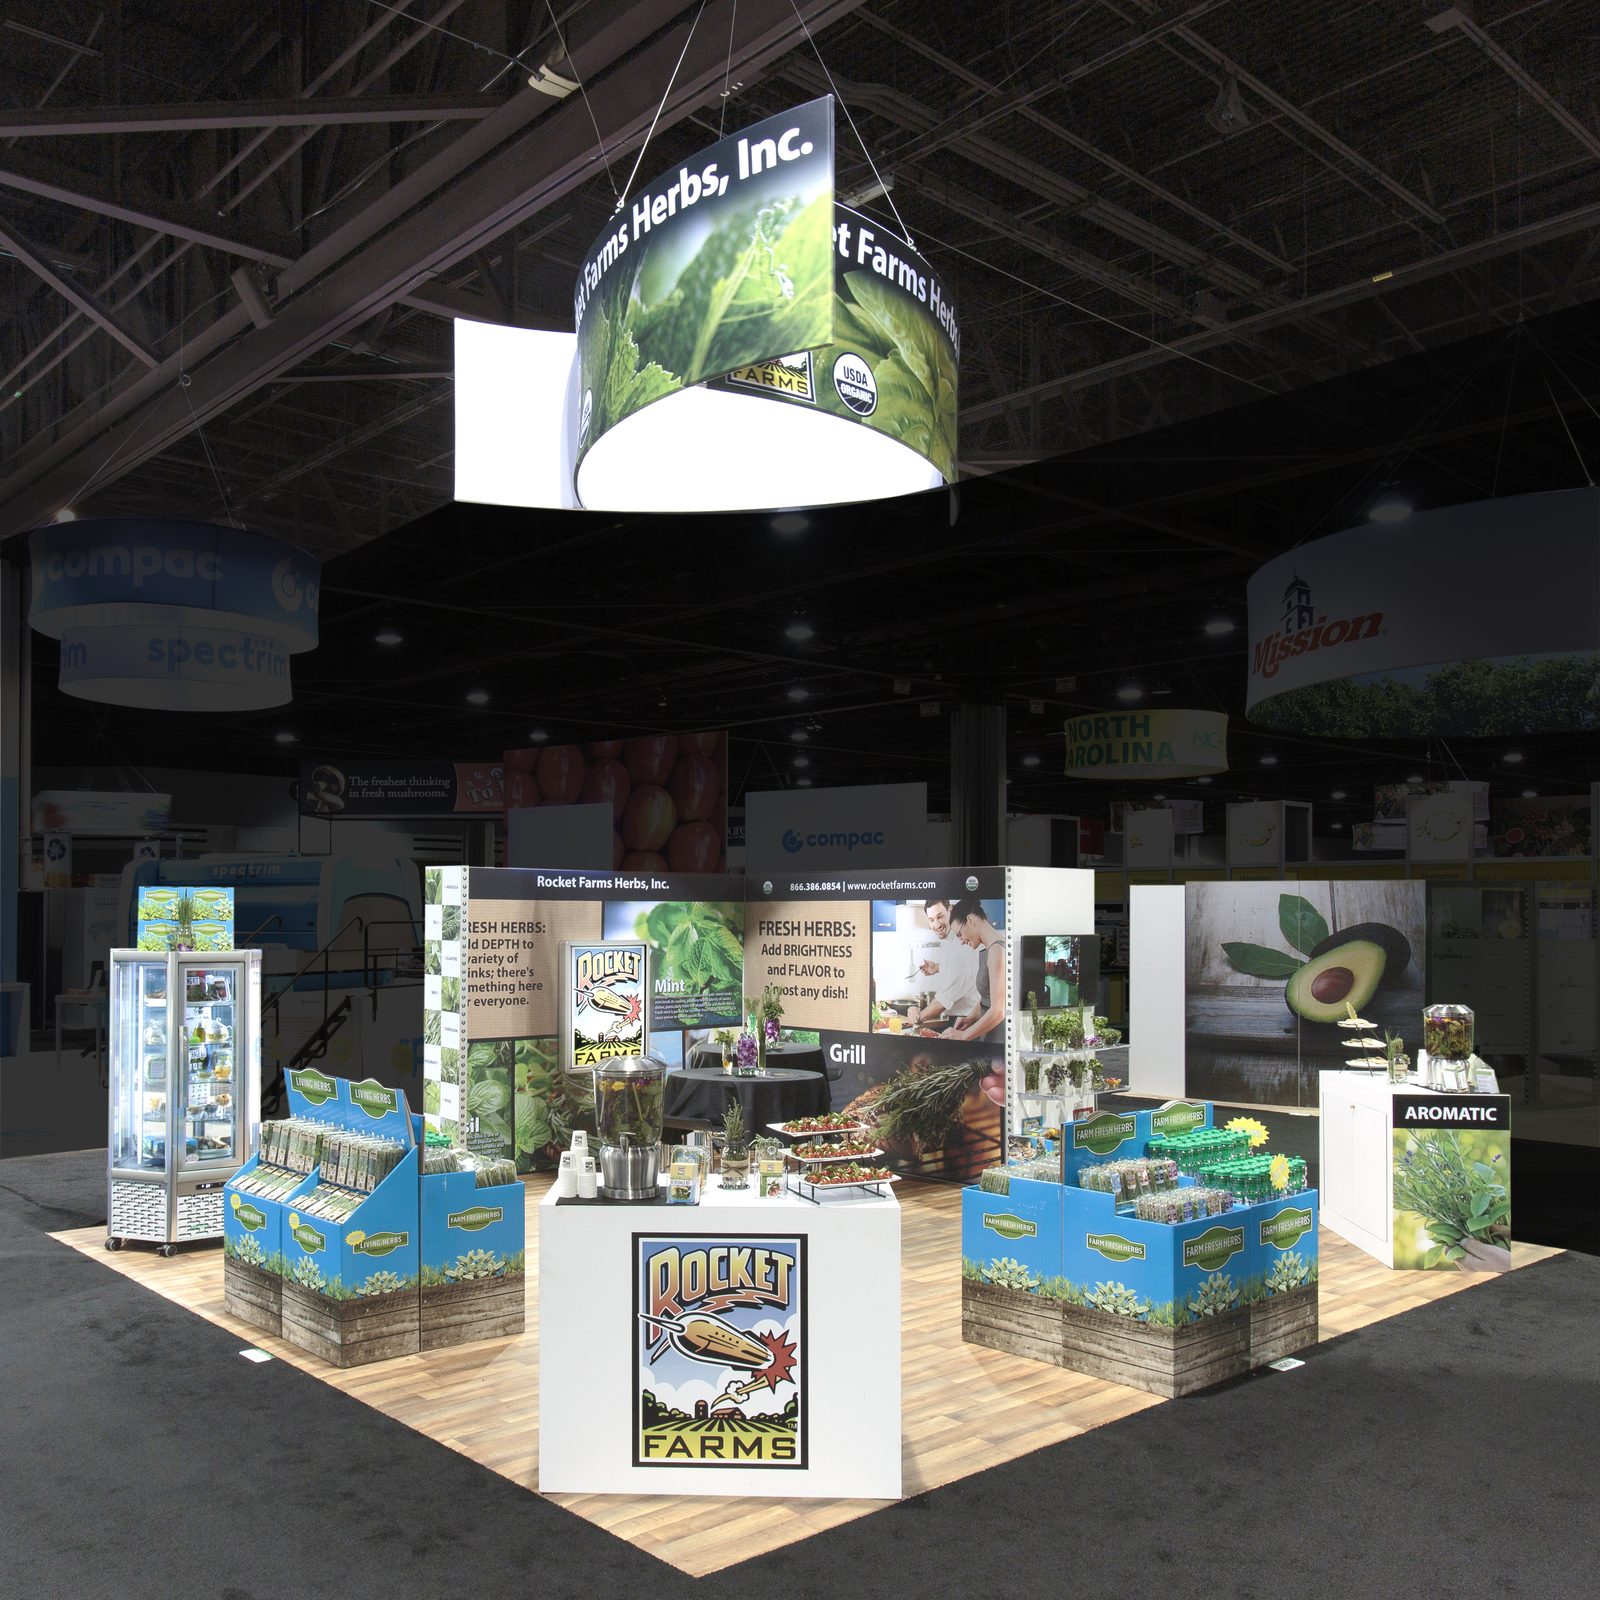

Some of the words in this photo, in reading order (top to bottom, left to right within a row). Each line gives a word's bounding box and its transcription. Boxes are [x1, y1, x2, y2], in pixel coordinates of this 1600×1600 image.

[584, 223, 628, 301] Farms
[633, 163, 729, 241] Herbs,
[738, 127, 813, 180] Inc.
[857, 228, 926, 303] Farms
[843, 365, 868, 387] USDA
[840, 383, 873, 404] ORGANIC
[47, 545, 225, 588] compac
[1253, 612, 1383, 678] Mission
[147, 635, 287, 680] spectrim
[1068, 715, 1150, 744] NORTH
[349, 776, 369, 787] The
[371, 776, 407, 787] freshest
[409, 776, 450, 789] thinking
[349, 788, 359, 798] in
[361, 787, 385, 798] fresh
[388, 788, 448, 798] mushrooms.
[806, 831, 884, 850] compac
[212, 863, 280, 878] spectrim
[537, 875, 577, 888] Rocket
[579, 876, 613, 889] Farms
[614, 877, 649, 891] Herbs,
[651, 878, 670, 889] Inc.
[790, 882, 841, 891] 866.386.0854
[847, 880, 936, 891] www.rocketfarms.com
[501, 921, 546, 934] HERBS:
[758, 920, 801, 937] FRESH
[804, 920, 856, 938] HERBS:
[482, 939, 520, 949] DEPTH
[523, 939, 534, 949] to
[761, 943, 781, 956] Add
[784, 944, 852, 958] BRIGHTNESS
[507, 952, 519, 964] of
[497, 967, 534, 978] there's
[576, 949, 641, 1008] ROCKET
[767, 963, 786, 976] and
[788, 964, 831, 978] FLAVOR
[834, 967, 845, 978] to
[519, 981, 543, 991] here
[655, 978, 685, 993] Mint
[800, 986, 820, 1001] any
[822, 985, 849, 999] dish!
[474, 997, 530, 1009] everyone.
[829, 1043, 866, 1065] Grill
[295, 1076, 313, 1089] LIVING
[313, 1080, 332, 1093] HERBS
[354, 1088, 373, 1100] LIVING
[373, 1092, 391, 1105] HERBS
[1153, 1117, 1169, 1128] FARM
[1169, 1114, 1187, 1125] FRESH
[1187, 1111, 1203, 1122] HERBS
[1404, 1106, 1497, 1122] AROMATIC
[1076, 1128, 1094, 1140] FARM
[1094, 1125, 1114, 1137] FRESH
[1114, 1121, 1134, 1133] HERBS
[450, 1215, 466, 1224] FARM
[466, 1213, 483, 1222] FRESH
[483, 1210, 501, 1220] HERBS
[985, 1217, 1000, 1226] FARM
[1000, 1219, 1016, 1230] FRESH
[1016, 1222, 1034, 1232] HERBS
[1262, 1225, 1278, 1237] FARM
[1278, 1220, 1295, 1233] FRESH
[1294, 1214, 1310, 1228] HERBS
[360, 1239, 382, 1249] LIVING
[382, 1236, 402, 1246] HERBS
[1089, 1237, 1105, 1247] FARM
[1105, 1239, 1123, 1250] FRESH
[1123, 1244, 1143, 1255] HERBS
[1186, 1245, 1204, 1257] FARM
[1204, 1240, 1223, 1253] FRESH
[1223, 1234, 1242, 1248] HERBS
[646, 1245, 796, 1350] ROCKET
[644, 1435, 796, 1460] FARMS
